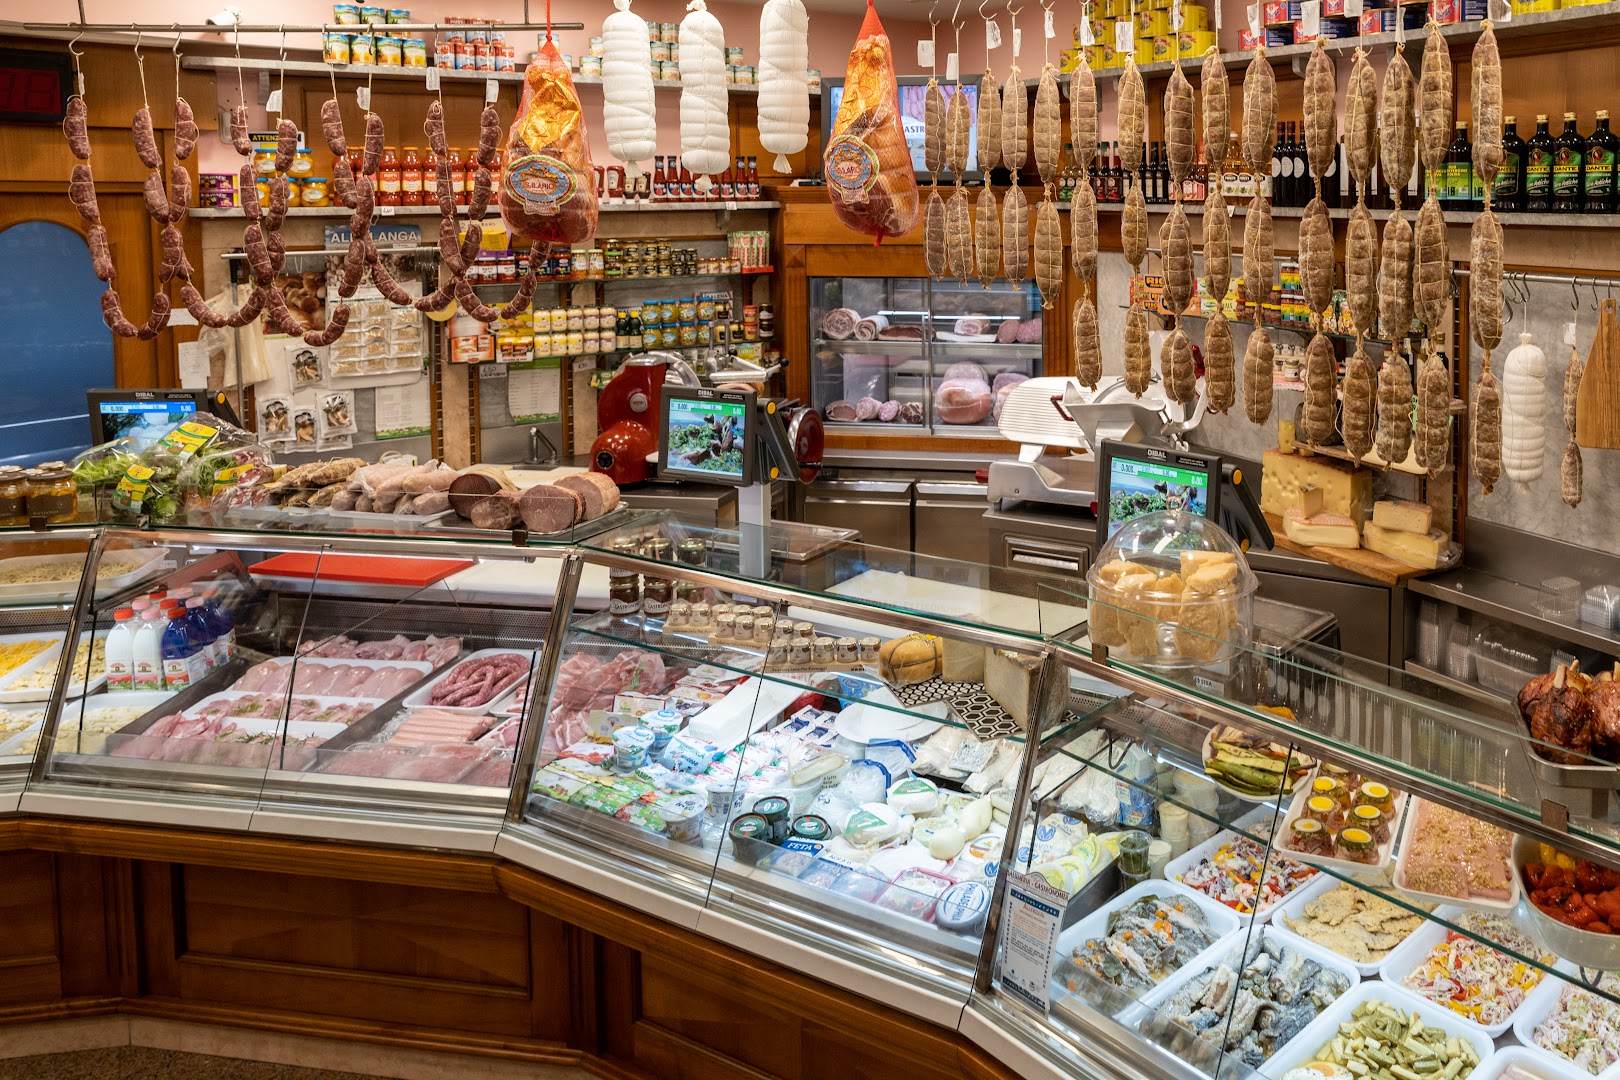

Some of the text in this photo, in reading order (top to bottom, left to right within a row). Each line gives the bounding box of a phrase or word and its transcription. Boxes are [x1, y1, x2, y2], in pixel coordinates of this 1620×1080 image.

[1147, 449, 1166, 458] DIBAL
[787, 842, 813, 851] FETA
[951, 883, 979, 921] PHILADELPHIA
